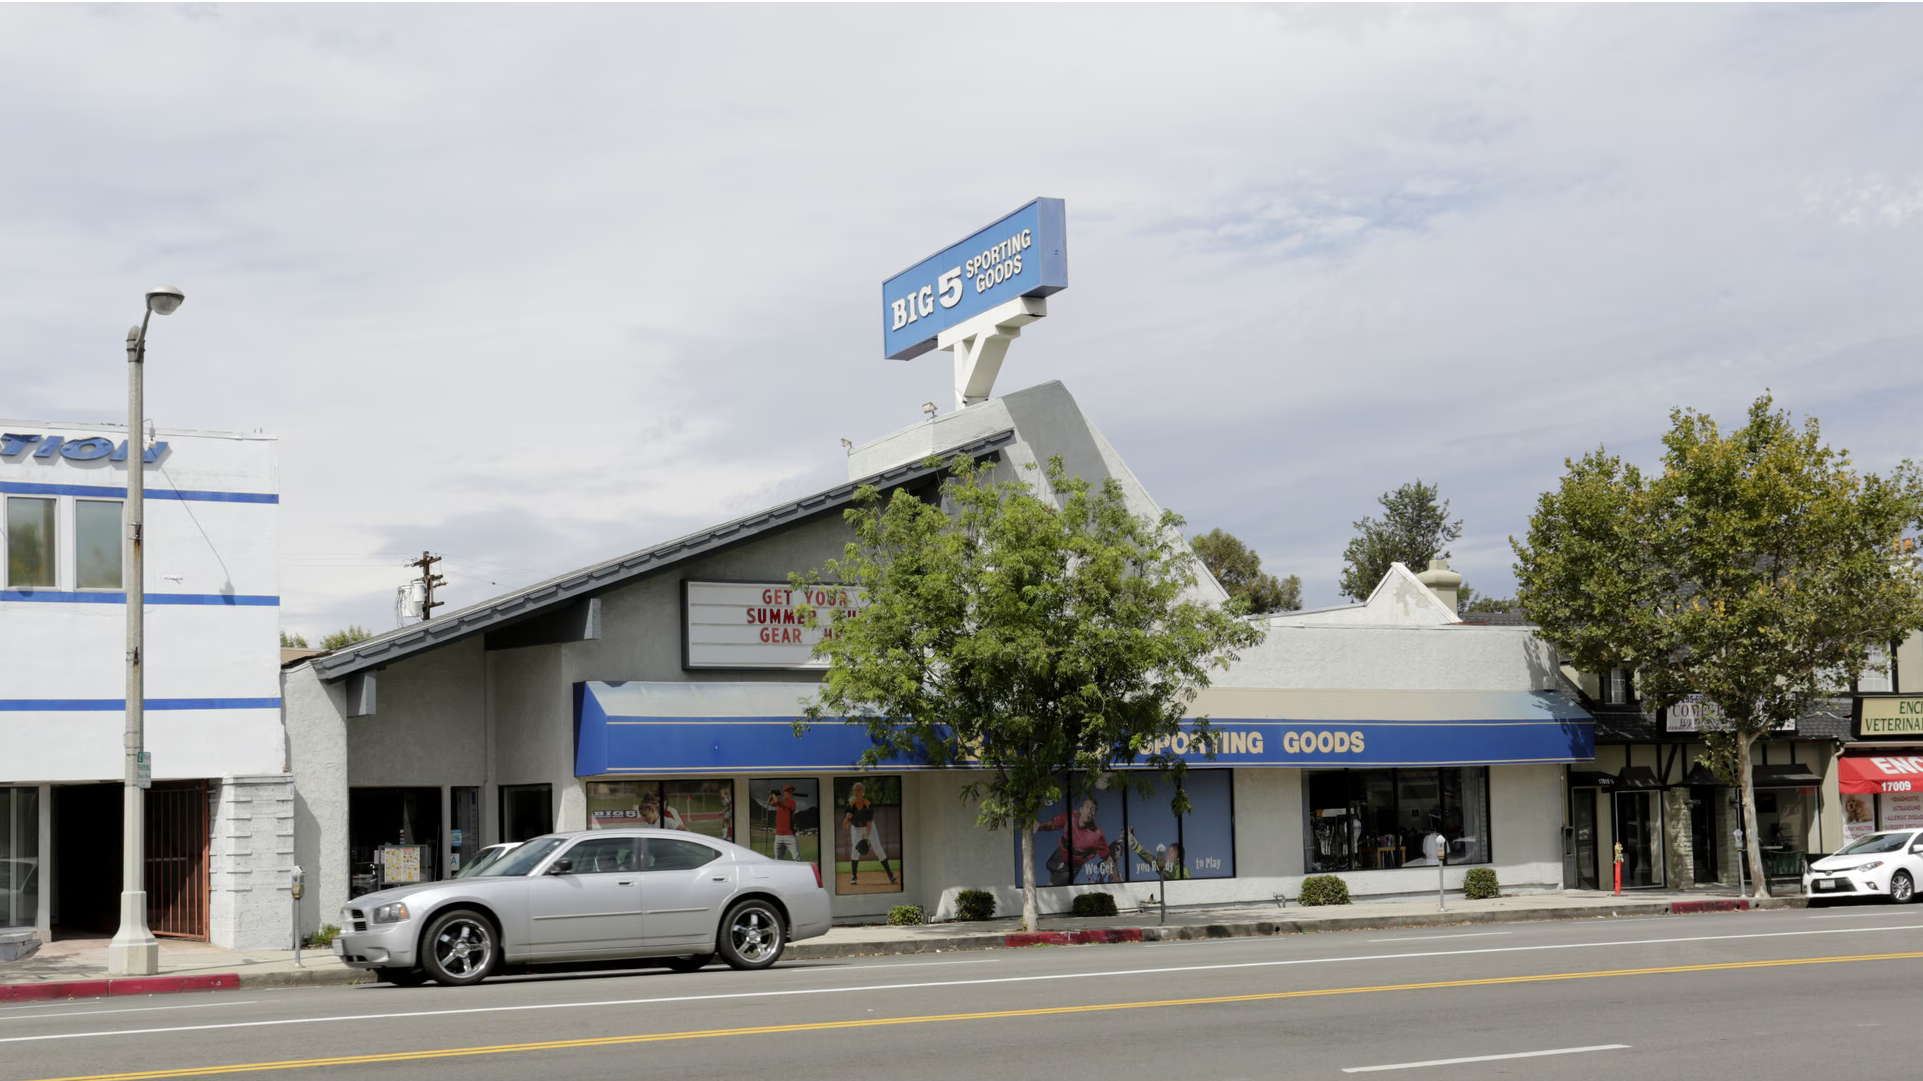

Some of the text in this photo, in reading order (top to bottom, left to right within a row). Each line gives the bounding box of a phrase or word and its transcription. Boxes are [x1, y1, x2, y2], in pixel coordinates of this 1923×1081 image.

[966, 228, 1031, 278] SPORTING
[976, 254, 1022, 294] GOODS
[892, 265, 963, 331] BIG 5
[762, 589, 848, 606] GET YOUR
[760, 627, 802, 643] GEAR
[1283, 731, 1365, 753] GOODS
[1882, 781, 1911, 791] 17009
[1085, 863, 1099, 875] We
[1100, 862, 1114, 875] Get
[1136, 863, 1149, 875] you
[1196, 857, 1204, 869] to
[1205, 856, 1221, 869] Play
